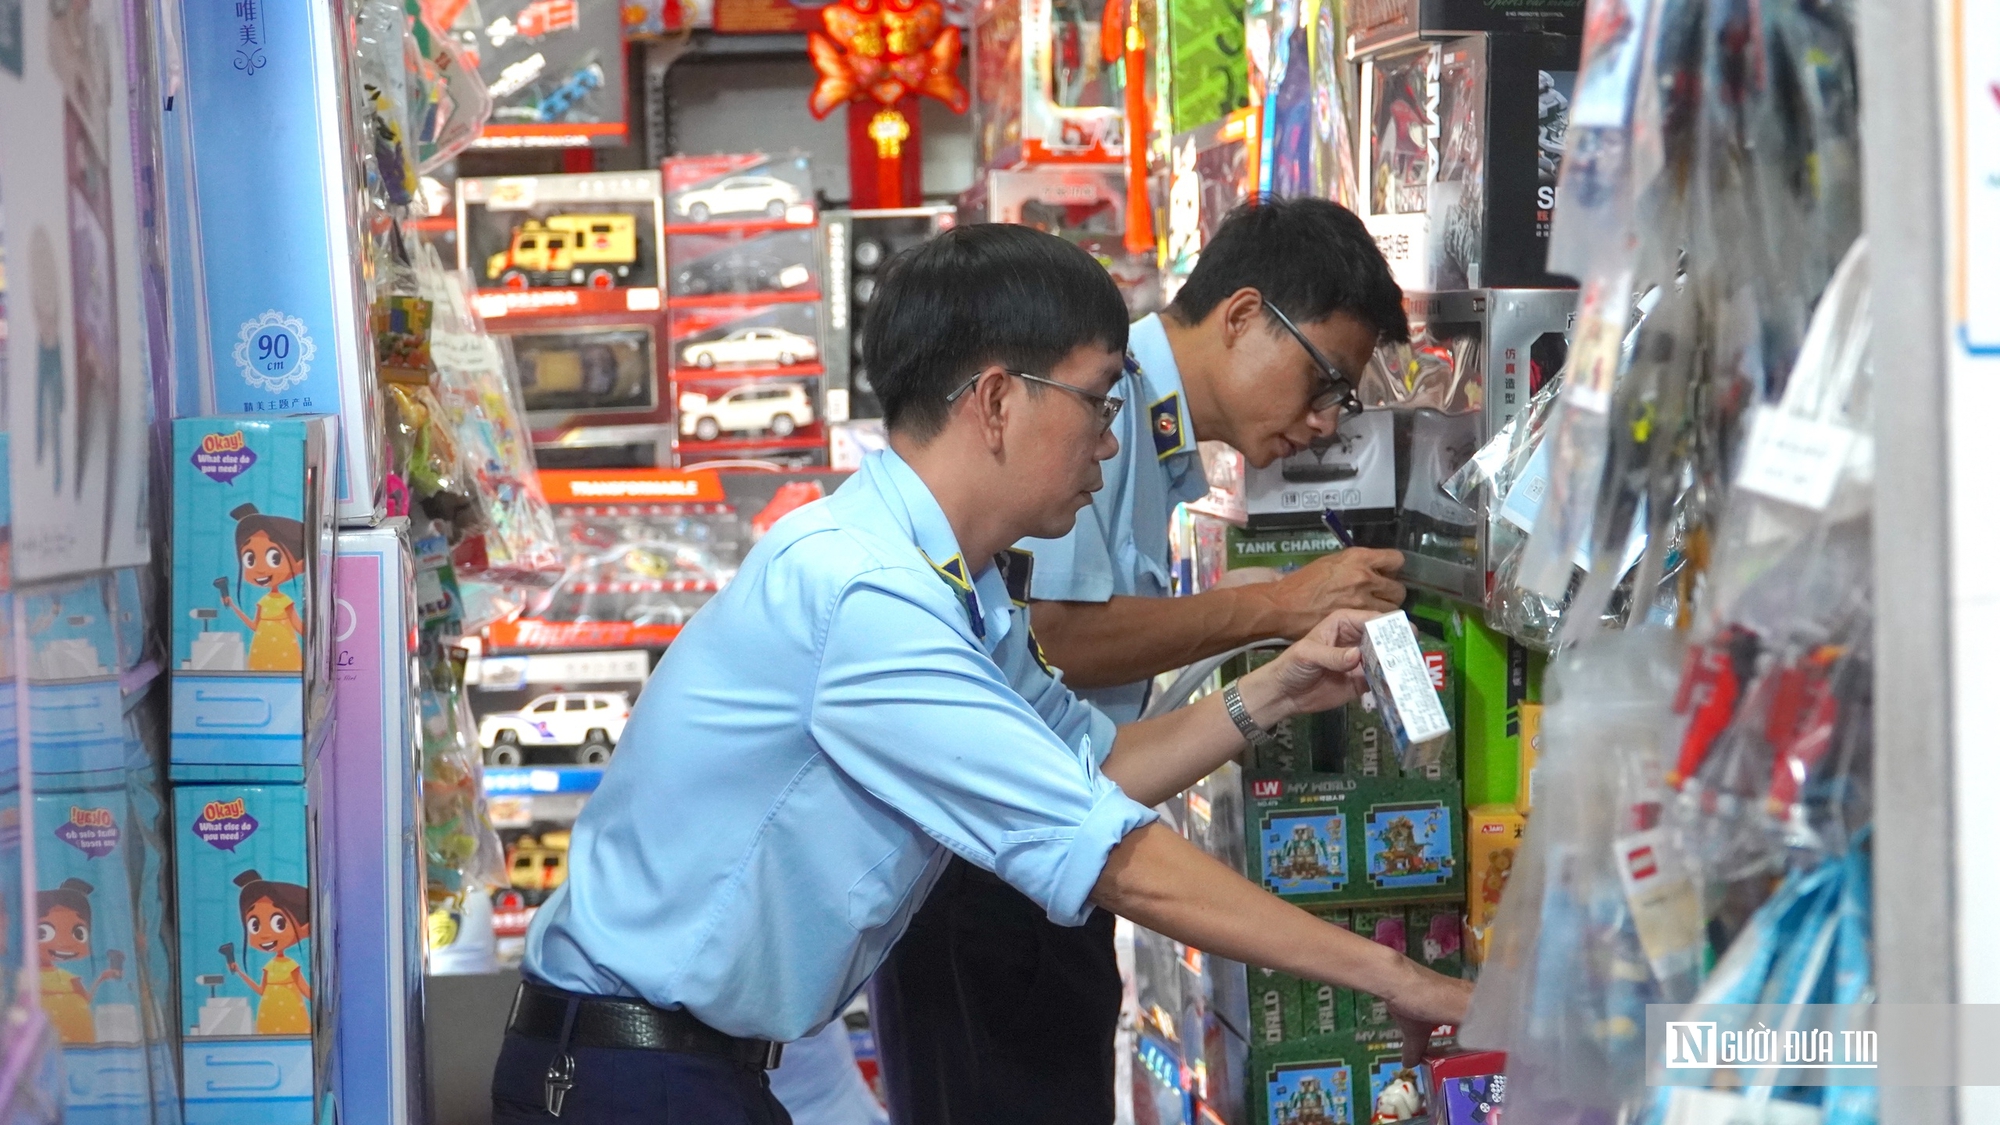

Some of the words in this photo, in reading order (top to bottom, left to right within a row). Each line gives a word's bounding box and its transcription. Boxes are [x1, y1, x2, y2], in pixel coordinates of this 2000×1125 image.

[258, 333, 290, 360] 90
[267, 361, 284, 371] cm
[203, 431, 244, 453] Okay!
[197, 454, 221, 463] What
[222, 455, 238, 463] else
[240, 454, 251, 463] do
[201, 465, 217, 474] you
[1236, 541, 1277, 555] TANK
[1425, 655, 1443, 687] LW
[1363, 727, 1378, 777] ORLD
[1255, 781, 1278, 796] LW
[1287, 782, 1309, 794] MY
[1311, 780, 1357, 792] WORLD
[203, 797, 245, 821] Okay!
[199, 822, 222, 831] What
[224, 822, 239, 831] else
[241, 822, 252, 831] do
[203, 833, 219, 842] you
[1265, 990, 1282, 1042] ORLD
